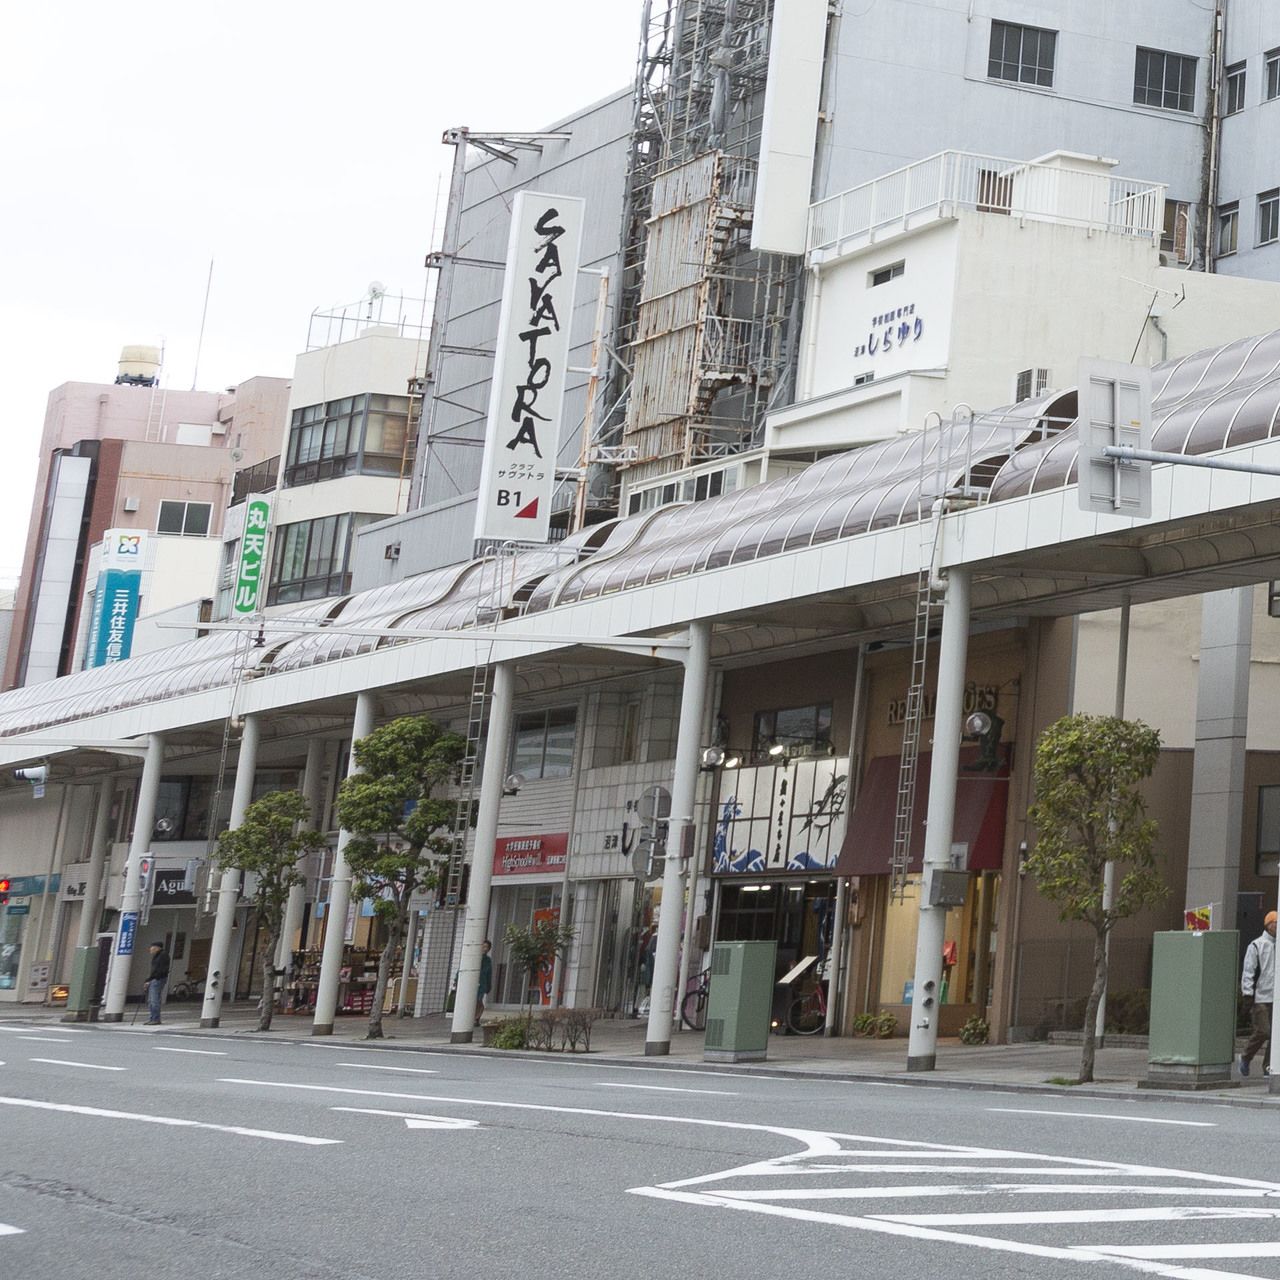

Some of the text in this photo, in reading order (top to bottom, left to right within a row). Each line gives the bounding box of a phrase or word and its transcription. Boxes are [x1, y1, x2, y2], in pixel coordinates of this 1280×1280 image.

[505, 207, 567, 459] SAVATORA
[868, 315, 923, 357] しらゆり
[498, 469, 545, 481] サヴァトラ
[510, 463, 535, 471] クラブ
[497, 489, 523, 508] B1
[235, 507, 267, 607] 丸天ビル
